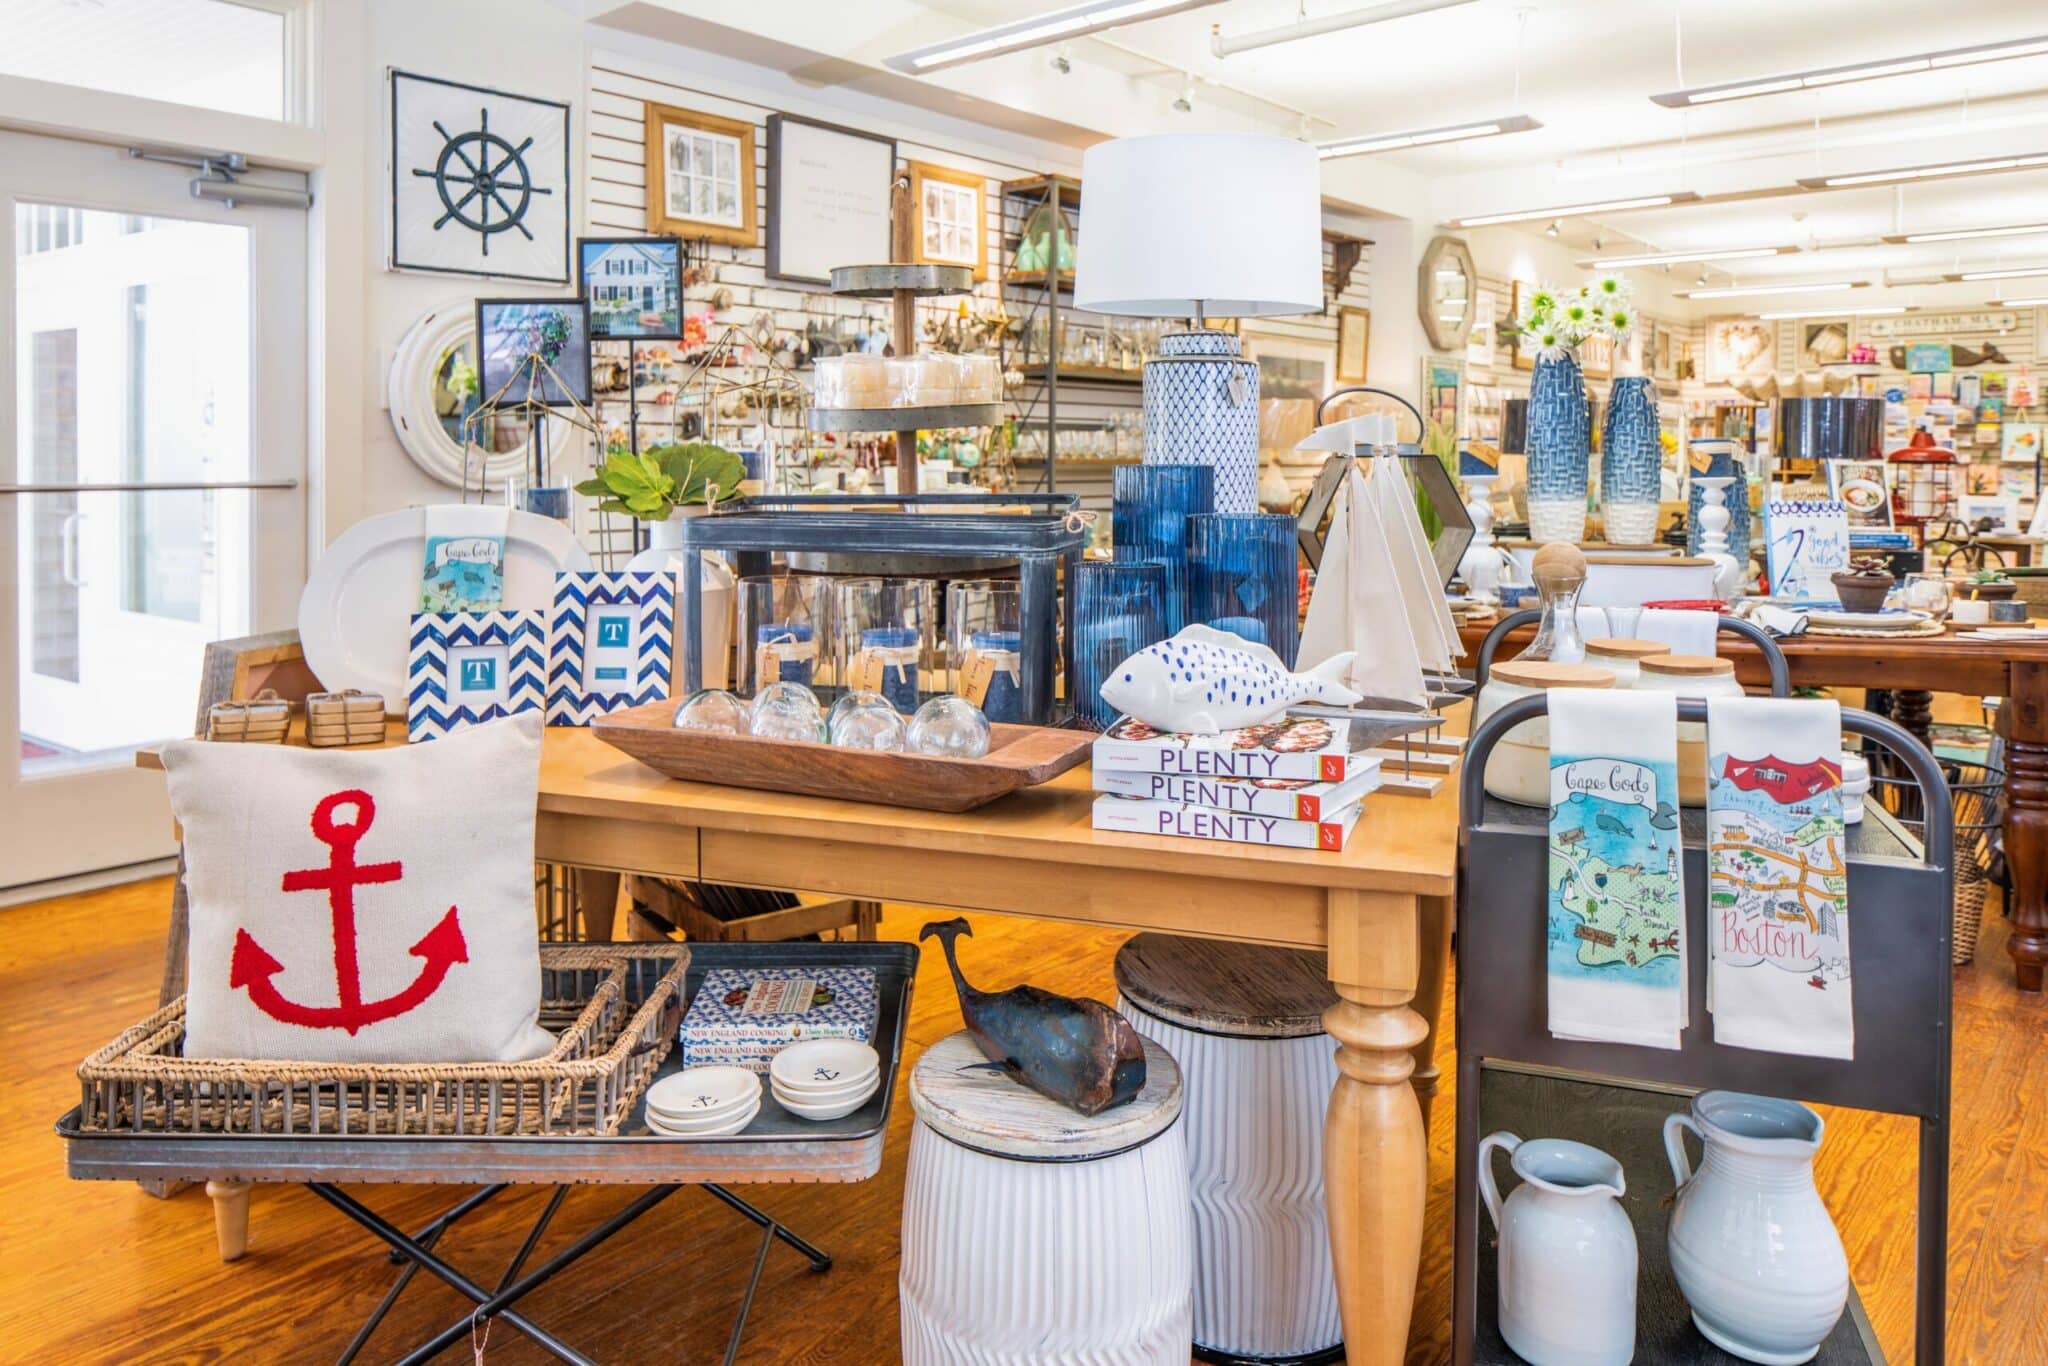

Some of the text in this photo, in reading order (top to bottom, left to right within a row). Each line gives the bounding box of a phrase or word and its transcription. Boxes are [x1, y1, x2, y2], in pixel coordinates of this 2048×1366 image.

[605, 623, 623, 641] T
[467, 661, 490, 682] T
[1160, 749, 1280, 776] PLENTY
[1151, 775, 1259, 811] PLENTY
[1565, 763, 1650, 795] Cape Cod
[1159, 810, 1278, 843] PLENTY
[1722, 909, 1820, 960] Boston
[711, 1029, 748, 1037] ENGLAND
[750, 1029, 787, 1037] COOKING
